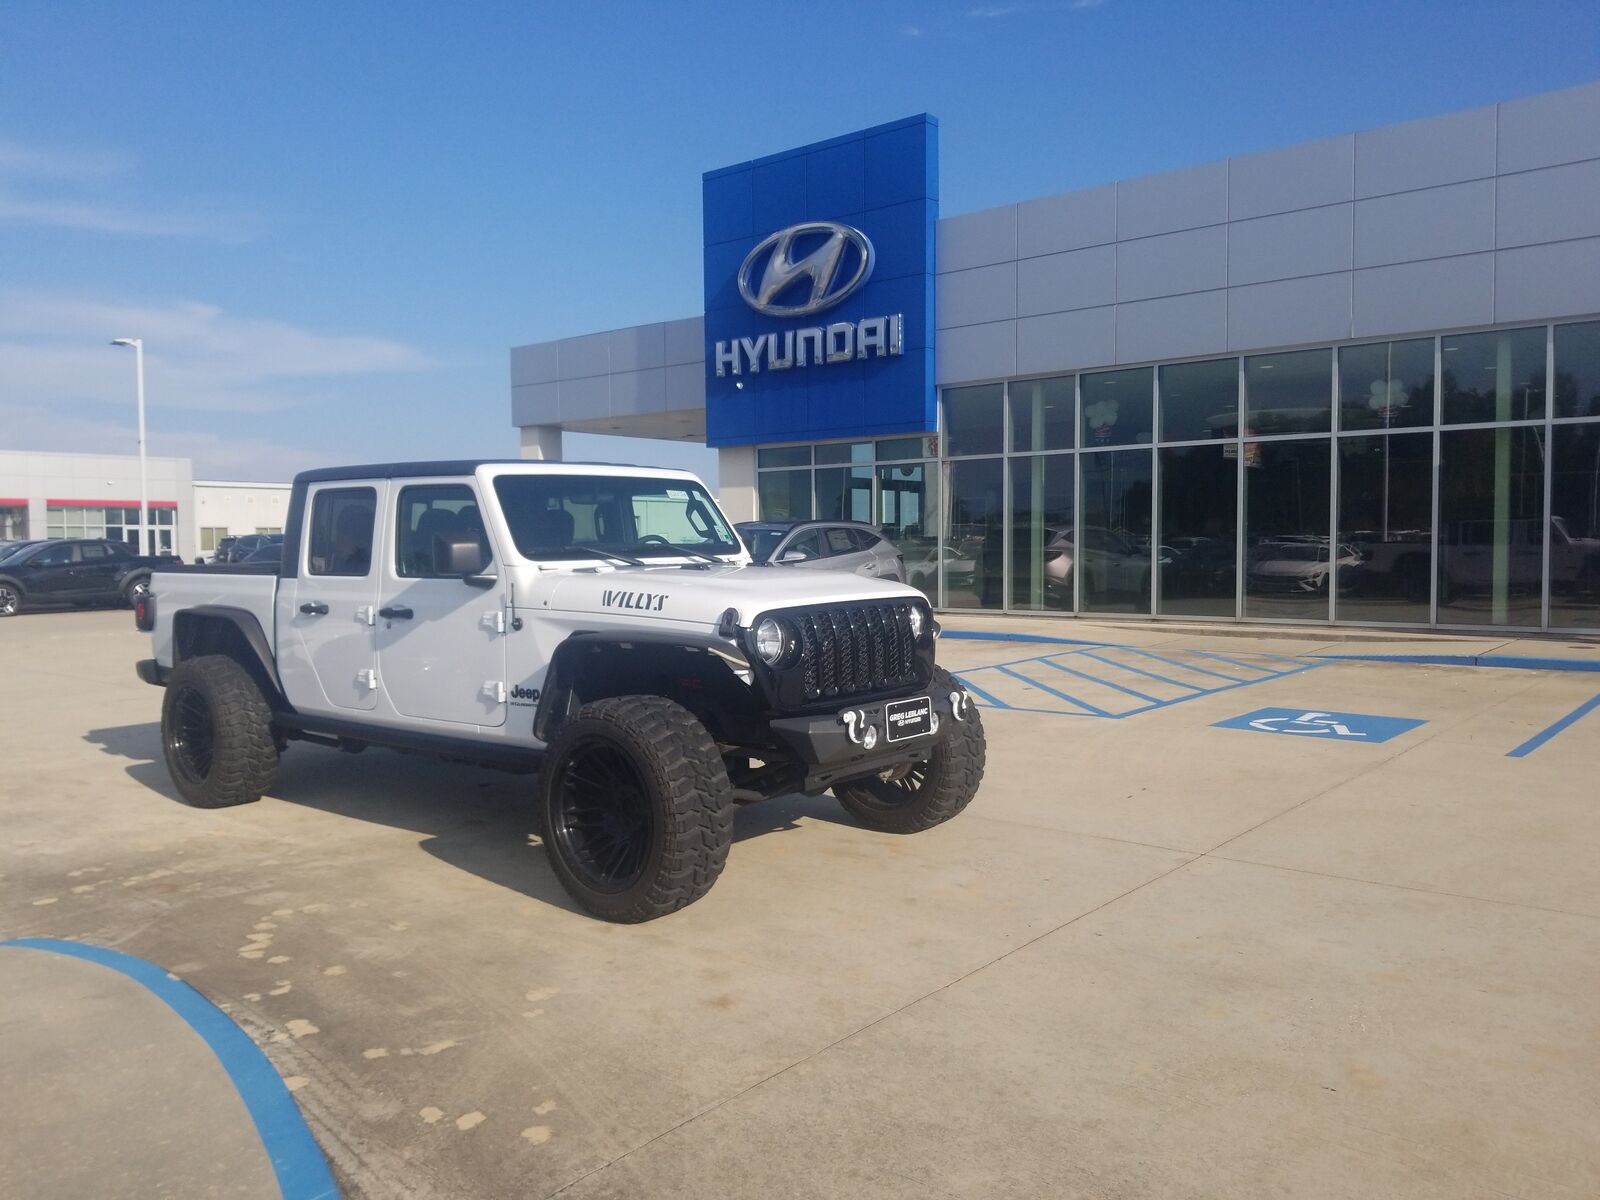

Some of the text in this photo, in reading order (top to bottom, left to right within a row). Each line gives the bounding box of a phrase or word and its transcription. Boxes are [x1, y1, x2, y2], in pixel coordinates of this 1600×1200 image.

[715, 313, 904, 377] HYUNDAI
[602, 590, 669, 611] WILLYS
[511, 684, 540, 702] Jeep
[889, 712, 905, 722] GREG
[905, 707, 928, 719] LEBLANC
